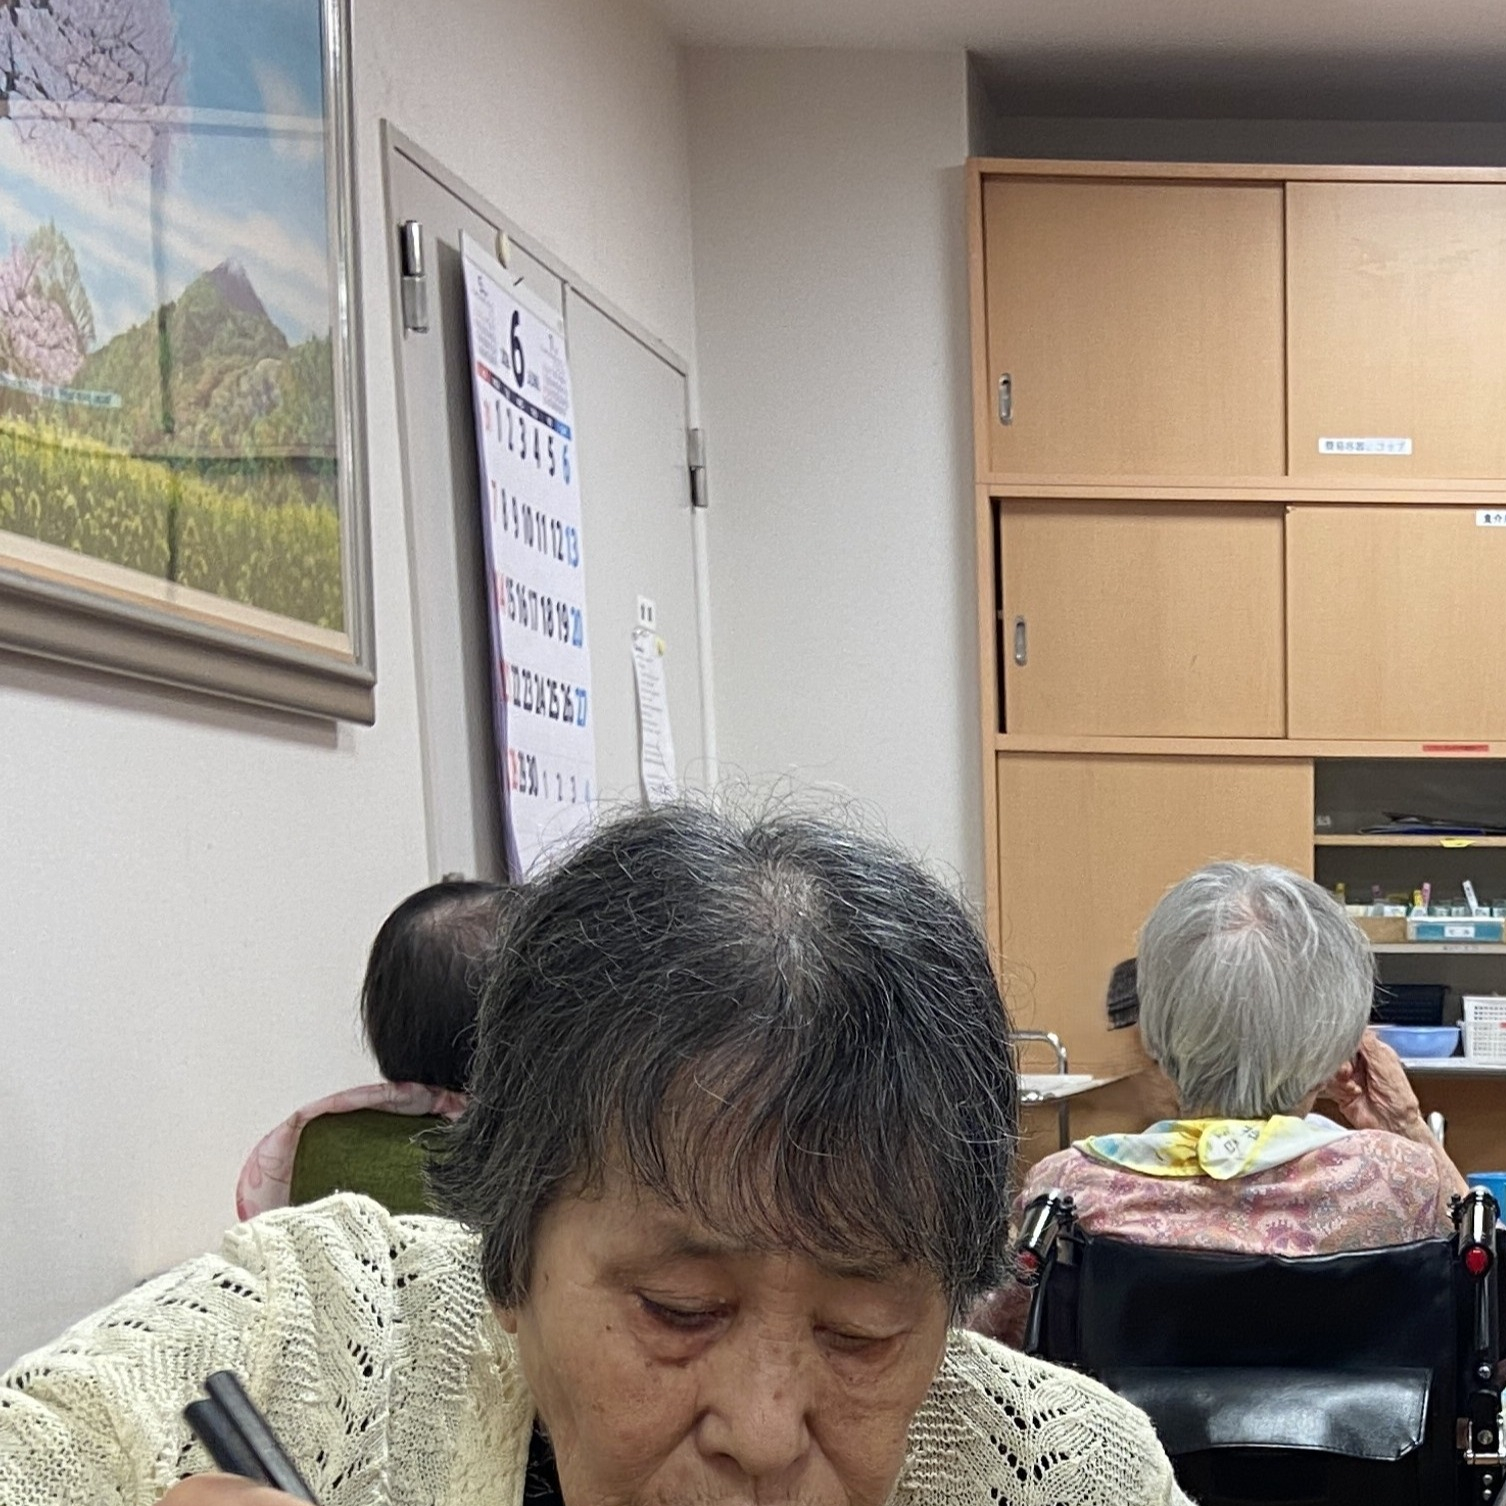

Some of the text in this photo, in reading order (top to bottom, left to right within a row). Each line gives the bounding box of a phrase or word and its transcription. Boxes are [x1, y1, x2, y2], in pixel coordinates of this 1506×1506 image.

[510, 310, 525, 389] 6
[519, 417, 527, 460] 3
[533, 428, 541, 469] 4
[548, 435, 556, 477] 5
[562, 444, 572, 485] 6
[511, 496, 520, 539] 9
[521, 504, 534, 547] 10
[535, 511, 548, 555] 11
[550, 518, 564, 561] 12
[565, 526, 580, 568] 13
[505, 577, 516, 621] 15
[516, 582, 529, 627] 16
[528, 589, 539, 631] 17
[541, 596, 554, 638] 18
[556, 602, 570, 643] 19
[570, 607, 584, 648] 20
[521, 668, 534, 711] 23
[534, 673, 546, 716] 24
[547, 678, 560, 720] 25
[560, 682, 574, 723] 26
[574, 687, 587, 727] 27
[526, 754, 539, 797] 30
[556, 773, 563, 801] 2
[570, 775, 577, 804] 3
